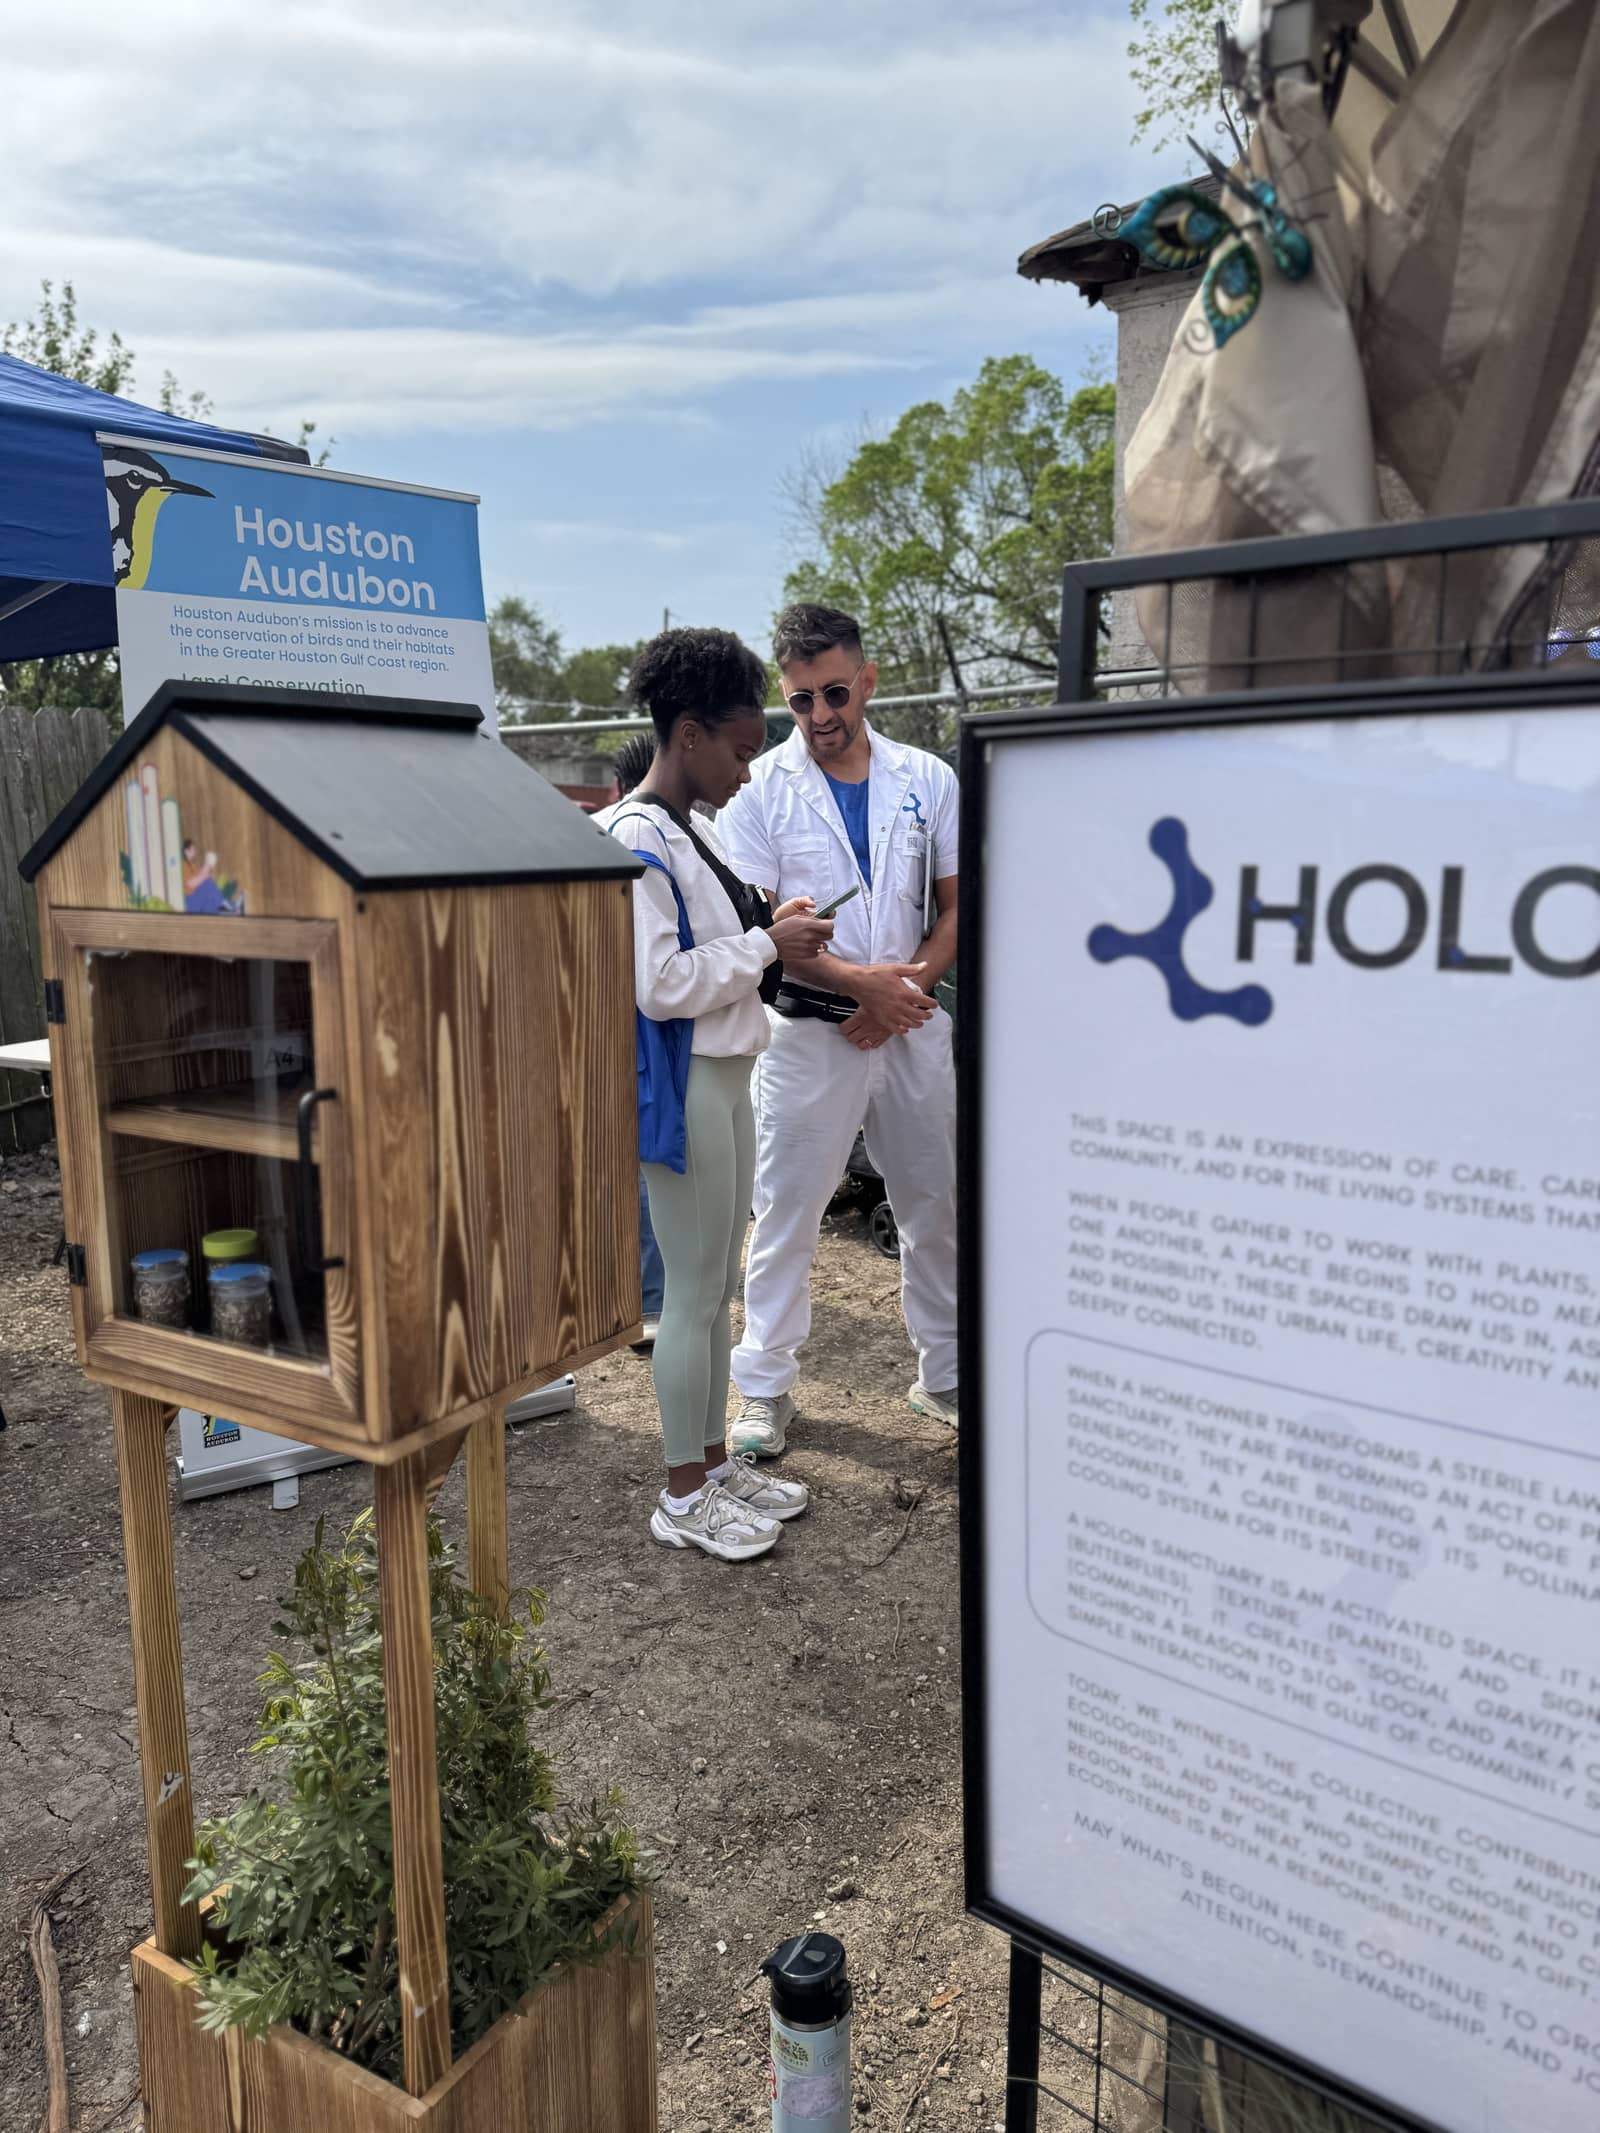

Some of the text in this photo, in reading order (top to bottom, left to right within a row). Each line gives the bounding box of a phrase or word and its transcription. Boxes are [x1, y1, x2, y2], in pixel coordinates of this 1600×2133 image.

[234, 506, 415, 564] Houston
[239, 556, 435, 610] Audubon
[170, 623, 455, 656] the conservation of birds and their habitats
[174, 604, 449, 639] Houston Audubon's mission is to advance
[180, 642, 450, 674] in the Greater Houston Gulf Coast region.
[1070, 1114, 1108, 1134] THIS
[1115, 1119, 1176, 1143] SPACE
[1185, 1128, 1206, 1148] IS
[1214, 1132, 1244, 1153] AN
[1253, 1137, 1392, 1173] EXPRESSION
[1403, 1157, 1440, 1180] OF
[1192, 1157, 1237, 1180] AND
[1241, 1164, 1287, 1187] FOR
[1292, 1171, 1332, 1194] THE
[1339, 1178, 1416, 1206] LIVING
[1423, 1189, 1536, 1224] SYSTEMS
[1067, 1190, 1119, 1215] WHEN
[1128, 1200, 1200, 1228] PEOPLE
[1209, 1214, 1292, 1244] GATHER
[1301, 1229, 1334, 1252] TO
[1344, 1236, 1413, 1265] WORK
[1424, 1249, 1483, 1277] WITH
[1068, 1215, 1104, 1236] ONE
[1219, 1242, 1235, 1261] A
[1246, 1247, 1312, 1276] PLACE
[1325, 1261, 1410, 1294] BEGINS
[1424, 1279, 1457, 1303] TO
[1470, 1287, 1540, 1319] HOLD
[1067, 1265, 1106, 1288] AND
[1109, 1274, 1182, 1304] REMIND
[1186, 1289, 1215, 1311] US
[1221, 1296, 1269, 1322] THAT
[1275, 1307, 1348, 1339] URBAN
[1415, 1336, 1555, 1383] CREATIVITY
[1068, 1240, 1105, 1264] AND
[1235, 1272, 1298, 1301] THESE
[1308, 1286, 1395, 1320] SPACES
[1403, 1305, 1472, 1335] DRAW
[1480, 1320, 1515, 1344] US
[1068, 1286, 1128, 1318] DEEPLY
[1066, 1364, 1544, 1502] WHEN A HOMEOWNER TRANSFORMS A STERILE
[1185, 1421, 1571, 1538] THEY ARE PERFORMING AN ACT OF
[1067, 1462, 1313, 1551] COOLING SYSTEM FOR ITS
[1198, 1450, 1571, 1568] THEY ARE BUILDING A SPONGE
[1208, 1478, 1480, 1572] A CAFETERIA FOR ITS
[1066, 1511, 1080, 1529] A
[1084, 1517, 1147, 1551] HOLON
[1150, 1538, 1264, 1589] SANCTUARY
[1269, 1576, 1291, 1598] IS
[1294, 1584, 1326, 1609] AN
[1330, 1595, 1455, 1651] ACTIVATED
[1559, 1668, 1582, 1693] IT
[1212, 1607, 1337, 1665] IT CREATES
[1218, 1584, 1509, 1695] TEXTURE AND
[1067, 1606, 1420, 1747] SIMPLE INTERACTION IS THE GLUE OF
[1067, 1583, 1576, 1775] NEIGHBOR A REASON TO AND ASK A
[1136, 1701, 1442, 1837] WE WITNESS THE COLLECTIVE
[1204, 1750, 1318, 1811] LANDSCAPE
[1067, 1742, 1565, 1963] REGION SHAPED BY AND
[1067, 1763, 1528, 1974] ECOSYSTEMS IS BOTH A RESPONSIBILITY AND A
[1179, 1766, 1579, 1943] AND THOSE WHO SIMPLY CHOSE TO
[1073, 1811, 1115, 1844] MAY
[1200, 1867, 1280, 1918] BEGUN
[1286, 1905, 1346, 1948] HERE
[1355, 1935, 1488, 2012] CONTINUE
[1499, 1999, 1538, 2034] TO
[1501, 2031, 1563, 2077] AND
